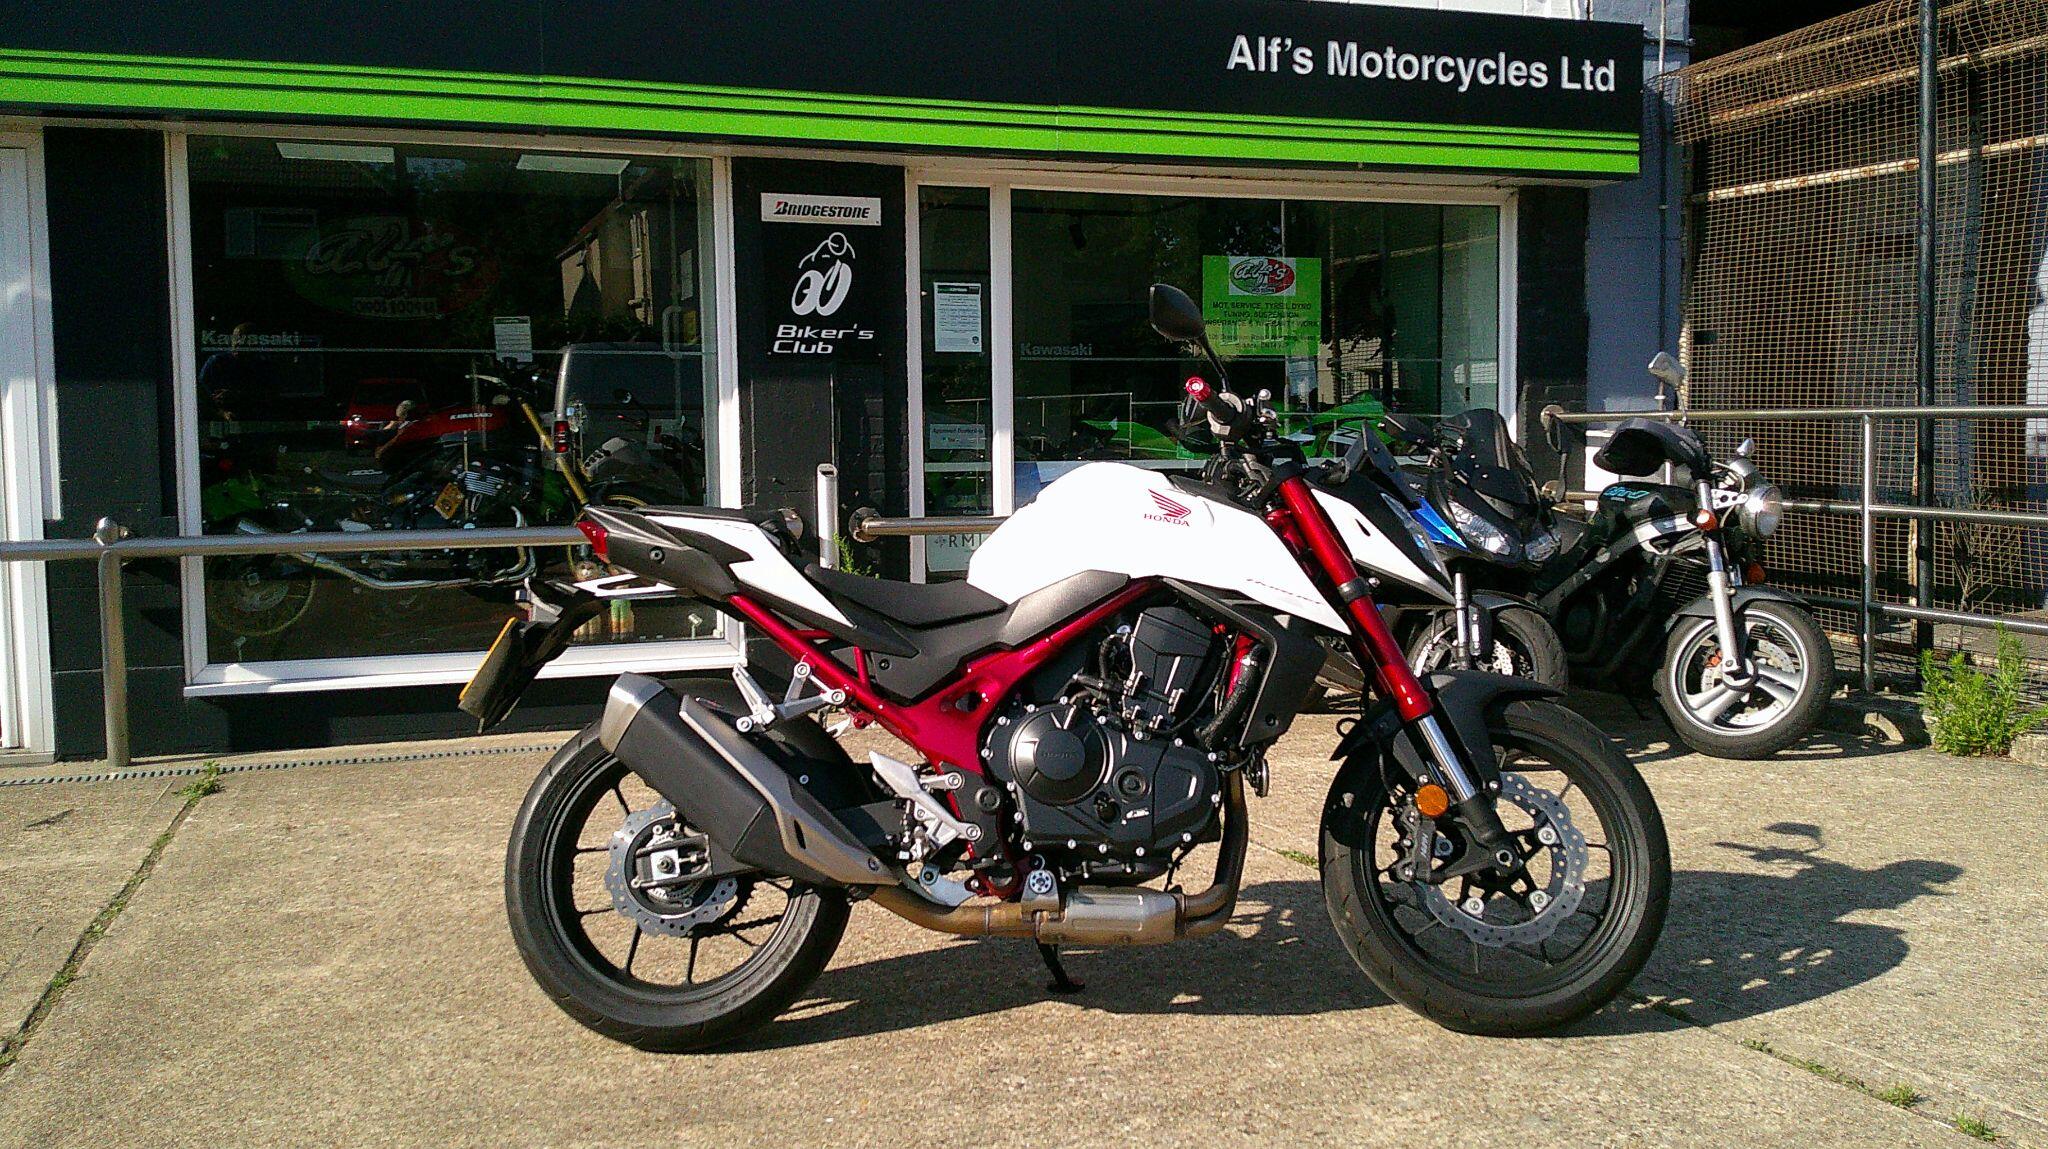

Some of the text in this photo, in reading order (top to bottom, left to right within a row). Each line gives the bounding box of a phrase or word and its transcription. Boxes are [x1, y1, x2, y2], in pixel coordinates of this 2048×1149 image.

[1227, 34, 1616, 92] Alf's Motorcycles Ltd
[774, 200, 871, 219] BRIDGESTONE
[201, 329, 301, 345] Kawasaki
[776, 323, 875, 340] Biker's
[773, 340, 833, 354] Club
[1020, 342, 1092, 356] Kawasaki
[1143, 512, 1191, 527] HONDA
